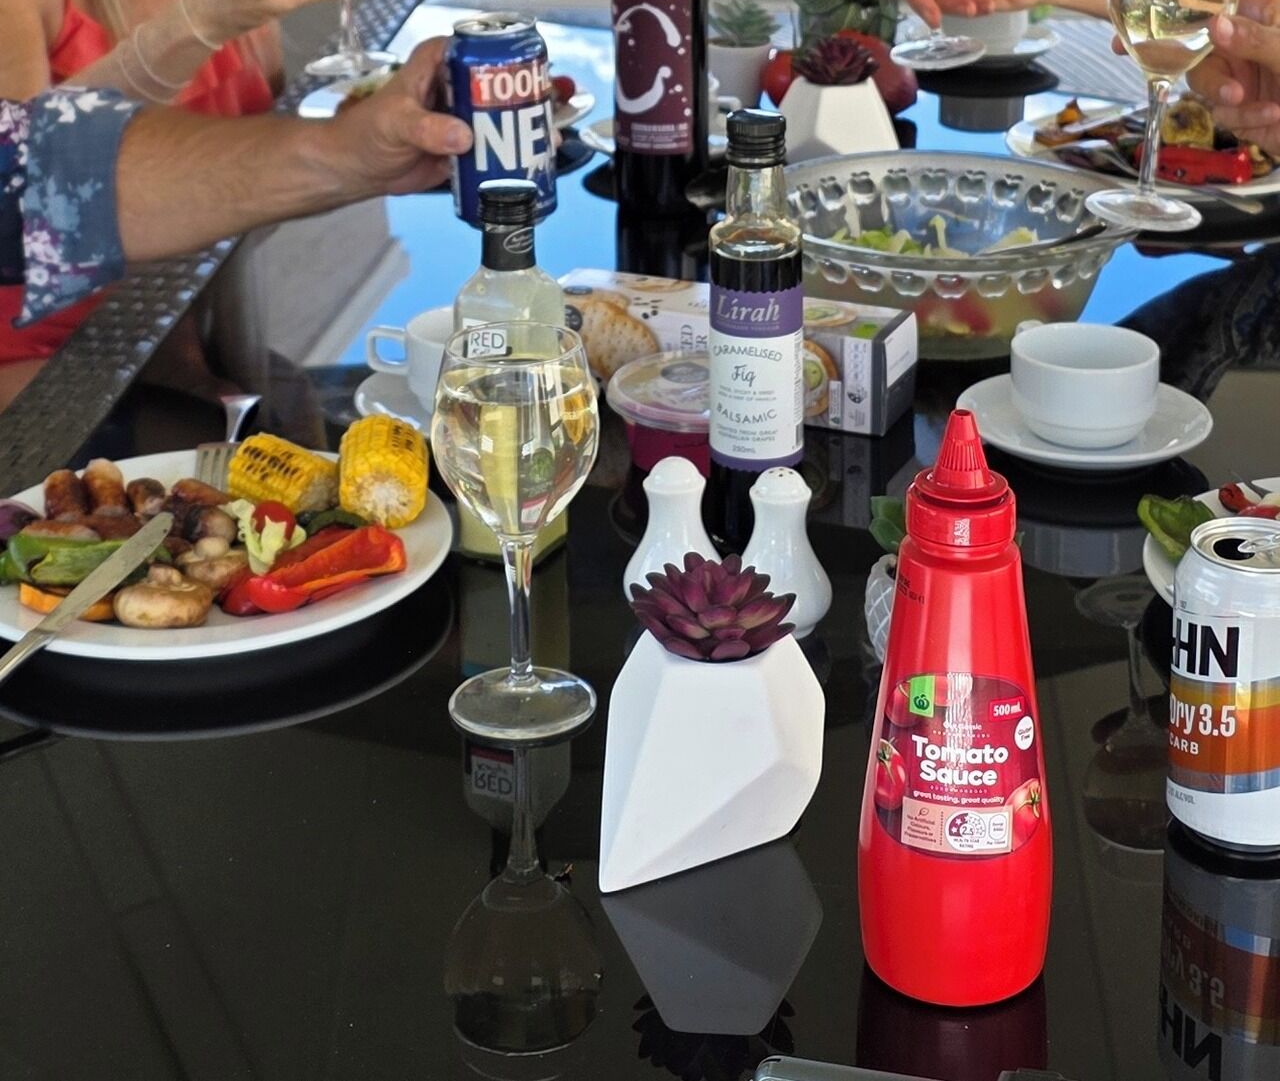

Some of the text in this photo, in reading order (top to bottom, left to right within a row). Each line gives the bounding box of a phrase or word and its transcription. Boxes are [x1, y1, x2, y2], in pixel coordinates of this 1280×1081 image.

[478, 62, 551, 101] TOOH
[472, 101, 555, 171] NE
[470, 332, 505, 349] RED
[713, 344, 783, 362] CARAMELISED
[717, 402, 777, 424] BALSAMIC
[1199, 703, 1236, 737] 3.5
[911, 734, 1009, 765] Tomato
[1169, 732, 1199, 755] CARB
[919, 760, 998, 787] Sauce
[913, 790, 932, 799] great
[960, 797, 980, 805] great
[981, 796, 1005, 805] quality
